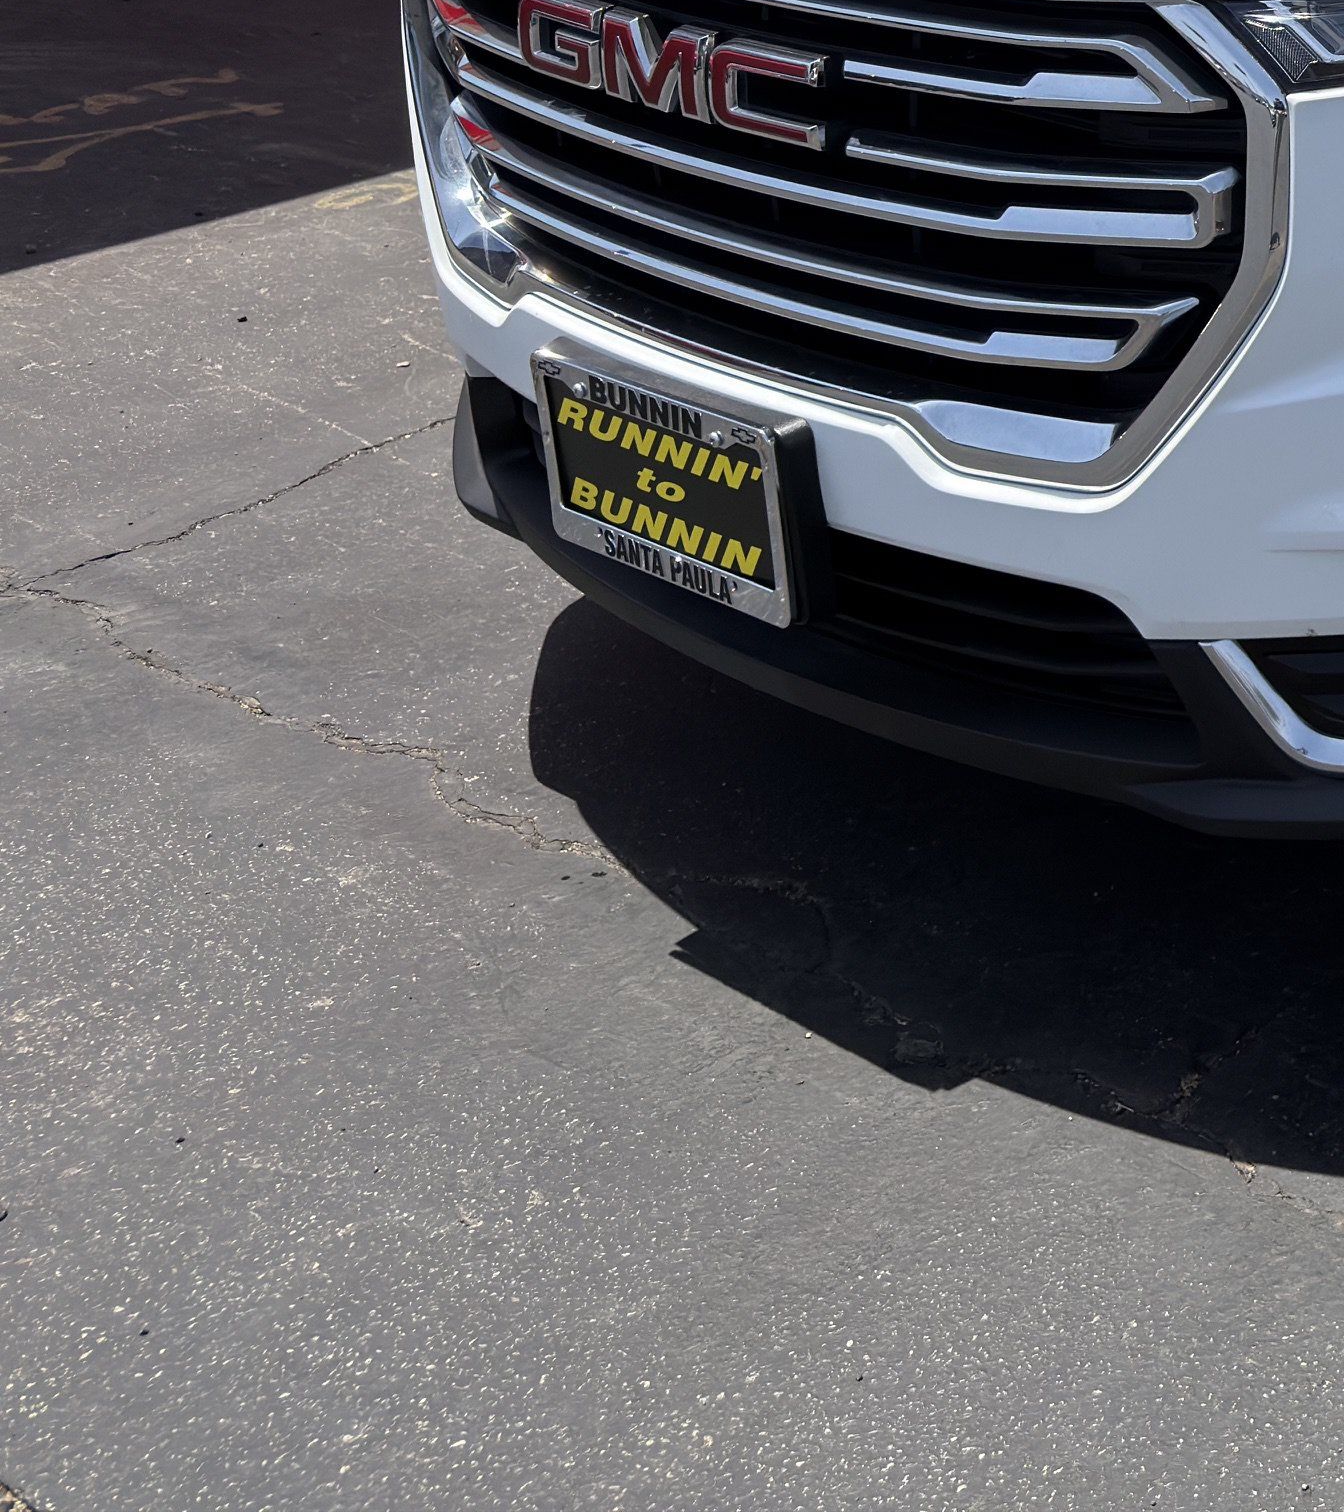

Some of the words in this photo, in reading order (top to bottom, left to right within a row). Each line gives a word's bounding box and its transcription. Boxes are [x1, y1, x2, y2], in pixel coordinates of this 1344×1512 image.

[557, 397, 763, 491] RUNNIN'
[588, 375, 702, 438] BUNNIN
[635, 467, 687, 502] to
[569, 477, 763, 577] BUNNIN
